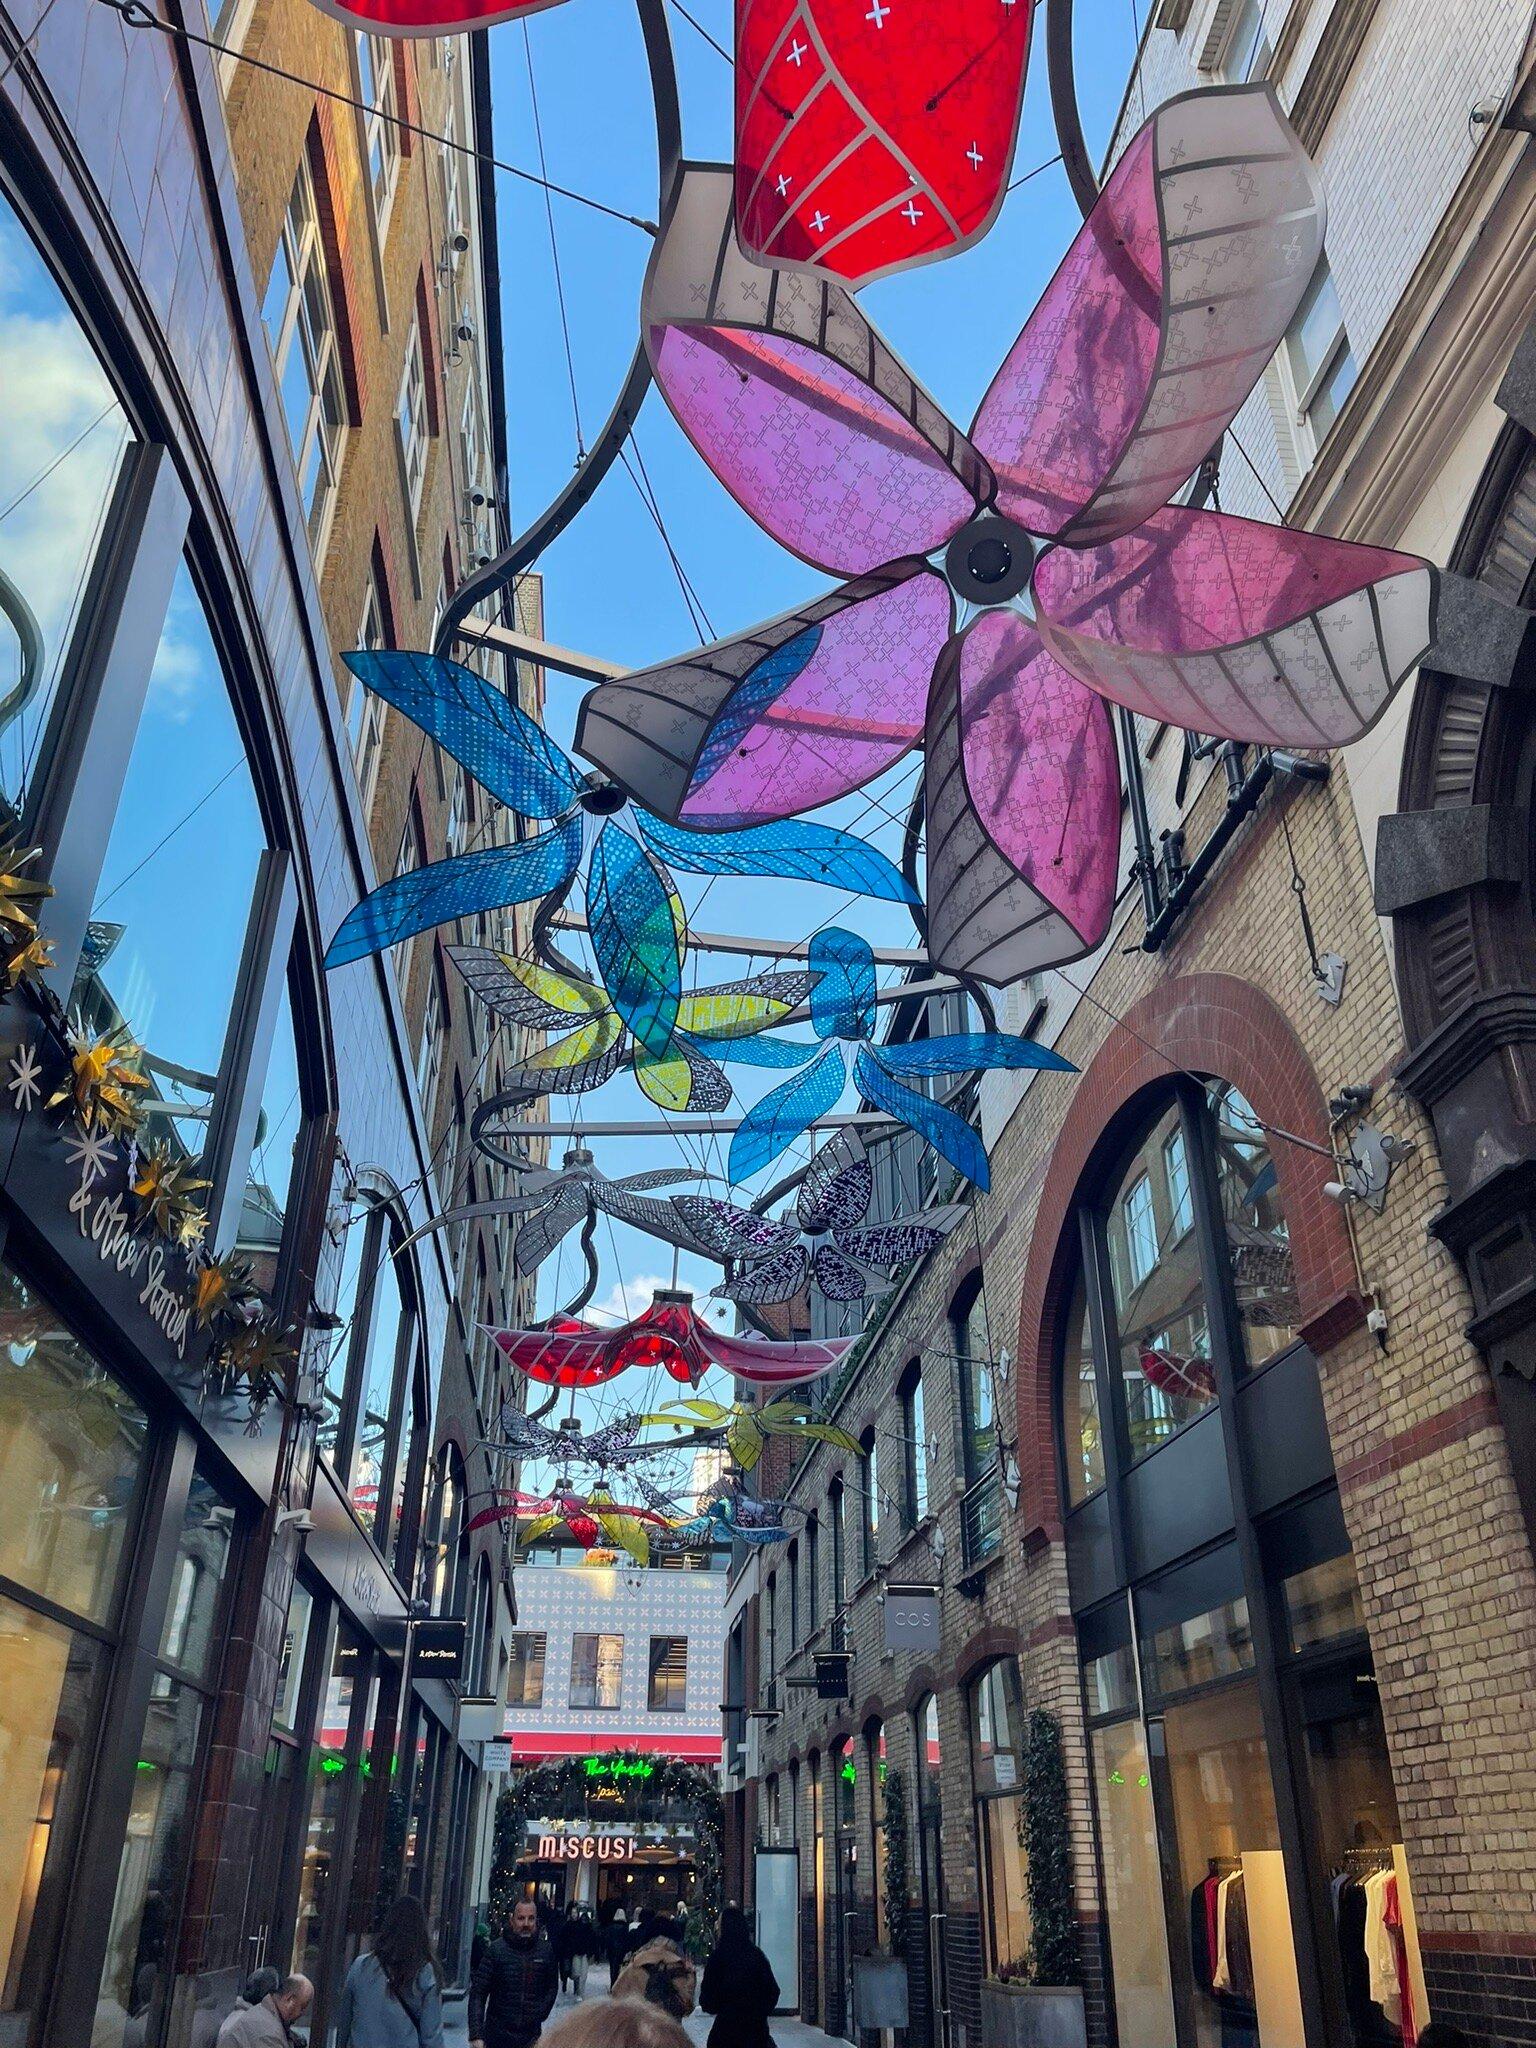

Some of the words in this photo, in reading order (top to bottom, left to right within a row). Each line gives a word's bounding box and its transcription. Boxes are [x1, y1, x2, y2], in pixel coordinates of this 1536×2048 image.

[894, 1612, 931, 1626] COS
[583, 1758, 608, 1776] The
[611, 1759, 653, 1779] Yards
